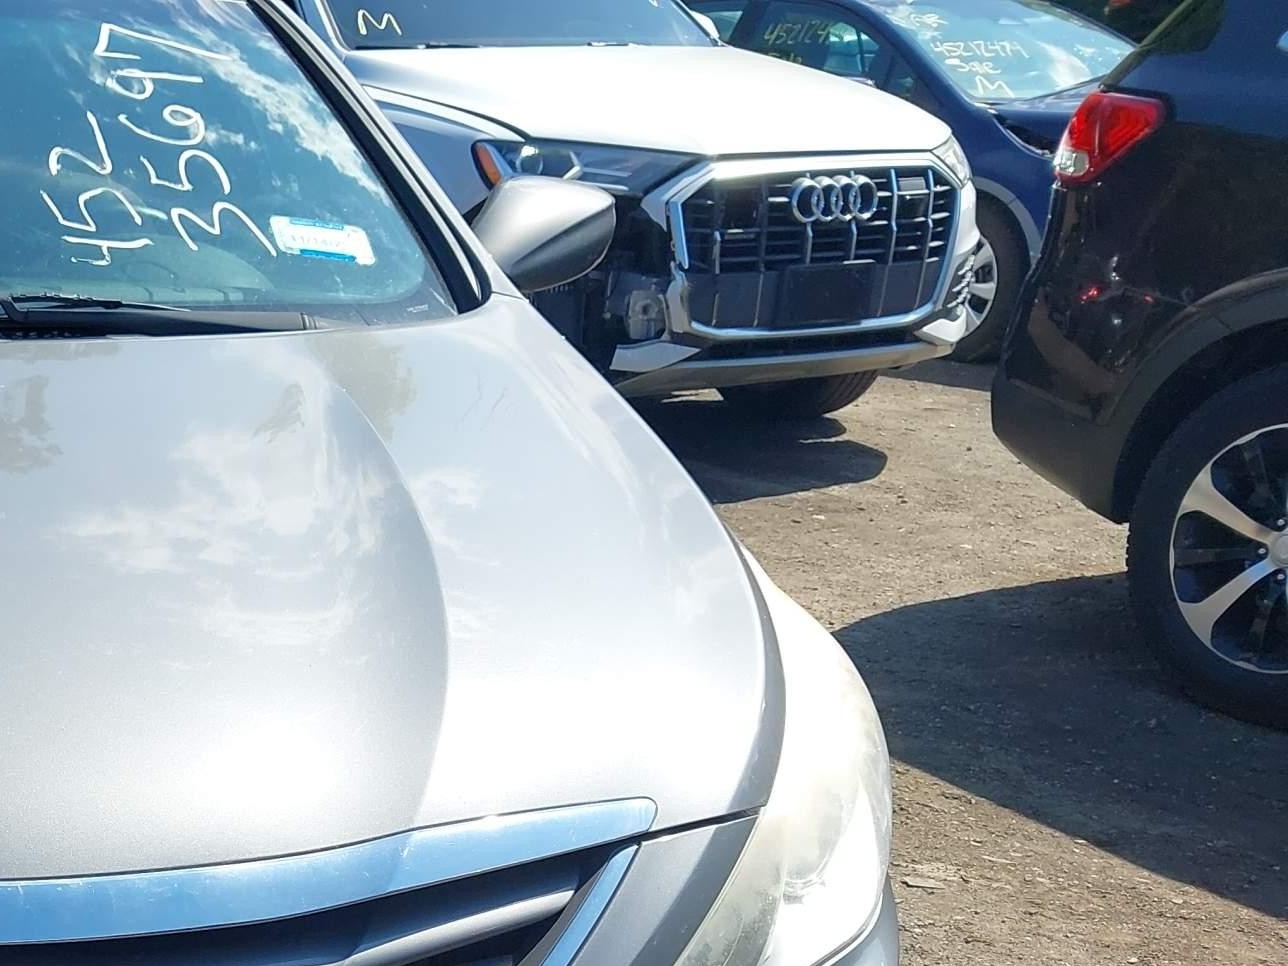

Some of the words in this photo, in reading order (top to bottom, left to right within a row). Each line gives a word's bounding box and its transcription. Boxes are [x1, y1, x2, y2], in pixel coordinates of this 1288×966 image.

[357, 8, 402, 36] M
[39, 110, 154, 266] 452
[93, 22, 278, 257] 35697
